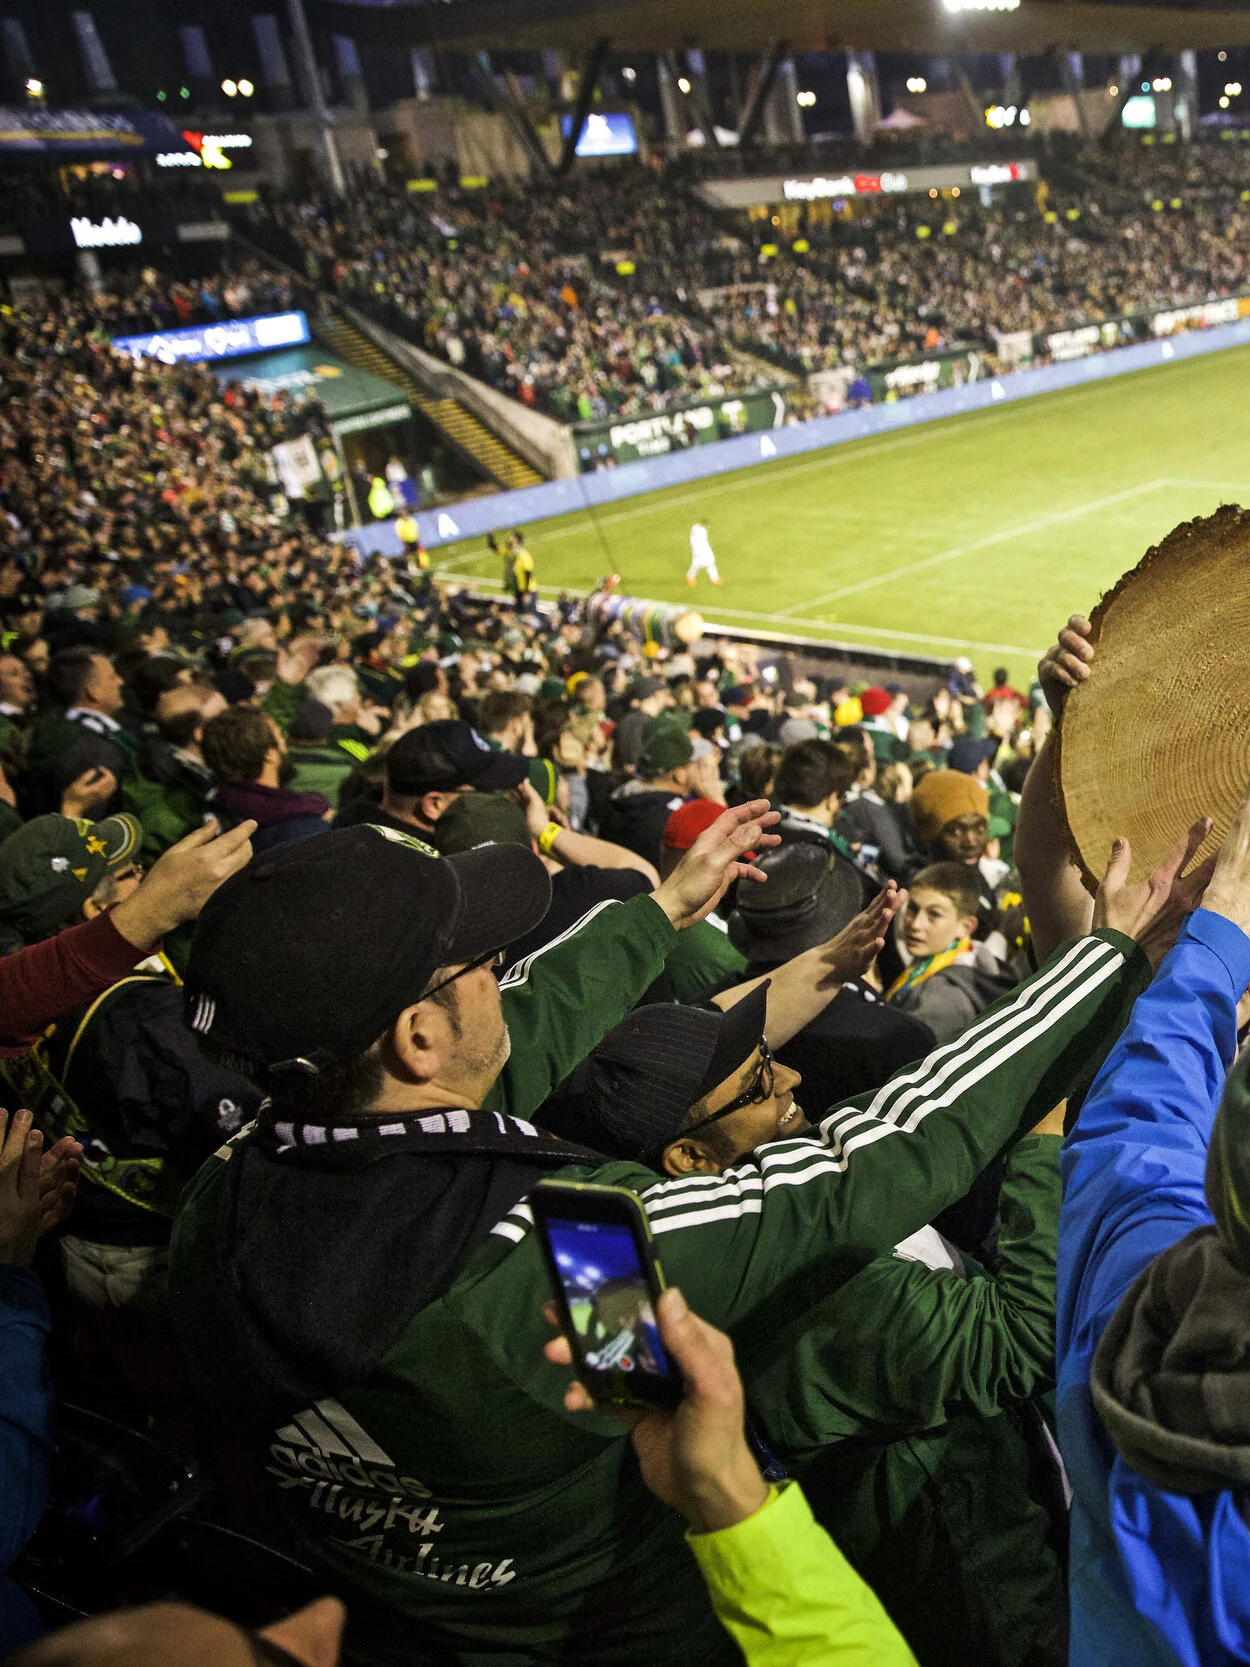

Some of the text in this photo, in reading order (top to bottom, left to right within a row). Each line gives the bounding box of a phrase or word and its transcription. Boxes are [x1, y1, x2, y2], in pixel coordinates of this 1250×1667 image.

[269, 1443, 433, 1498] adidas
[265, 1466, 445, 1536] Alaska
[326, 1533, 516, 1591] Airlines
